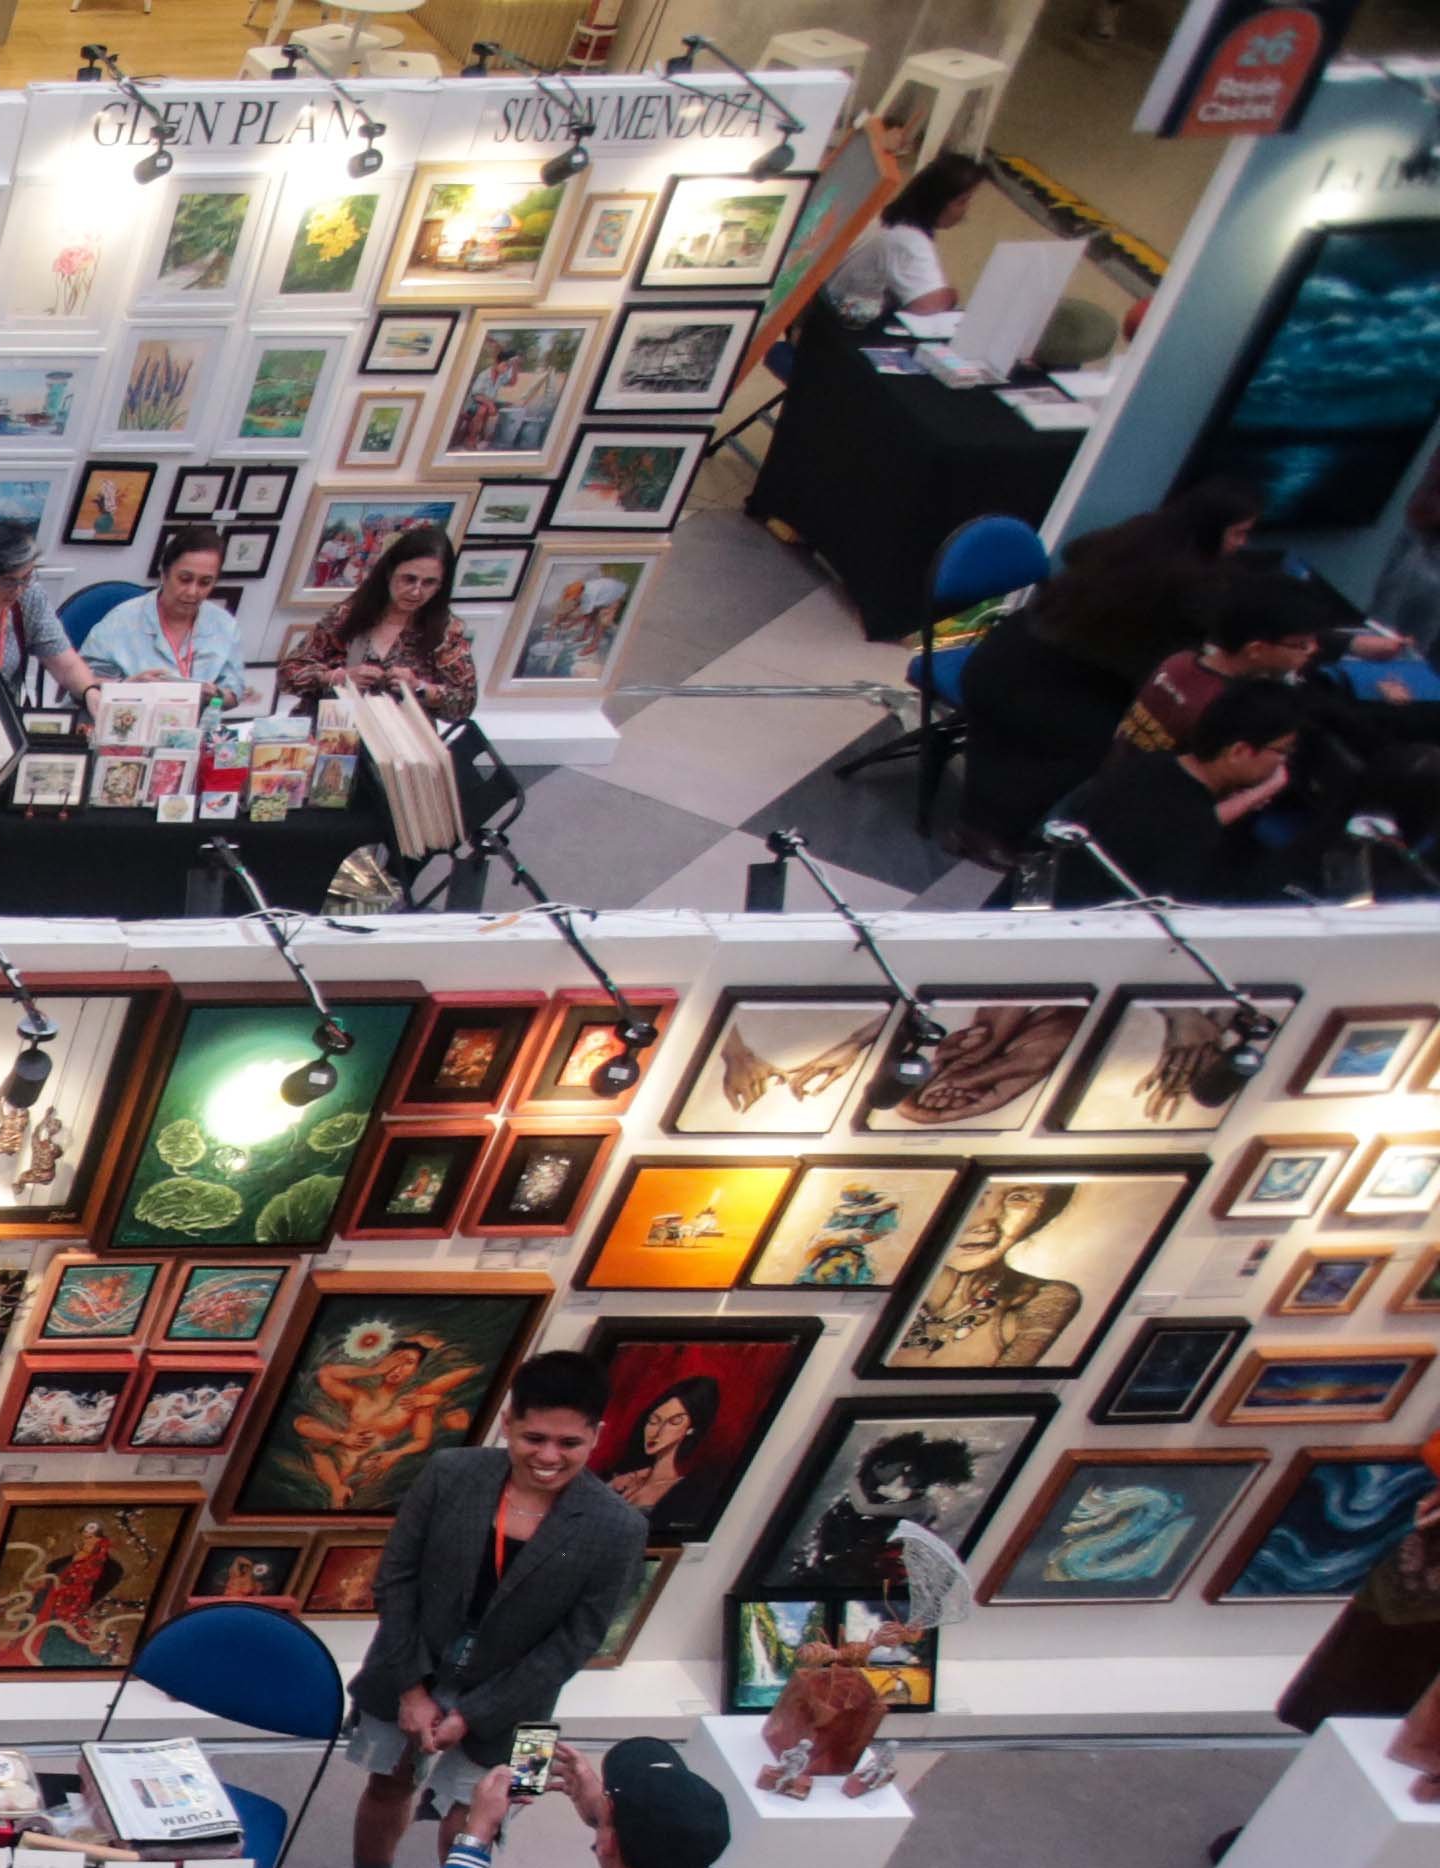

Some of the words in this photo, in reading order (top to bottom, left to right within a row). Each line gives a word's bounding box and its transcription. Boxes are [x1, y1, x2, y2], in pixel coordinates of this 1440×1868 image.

[93, 100, 226, 147] GLEN
[493, 97, 606, 144] SUSAN
[602, 92, 764, 142] MENDOZA
